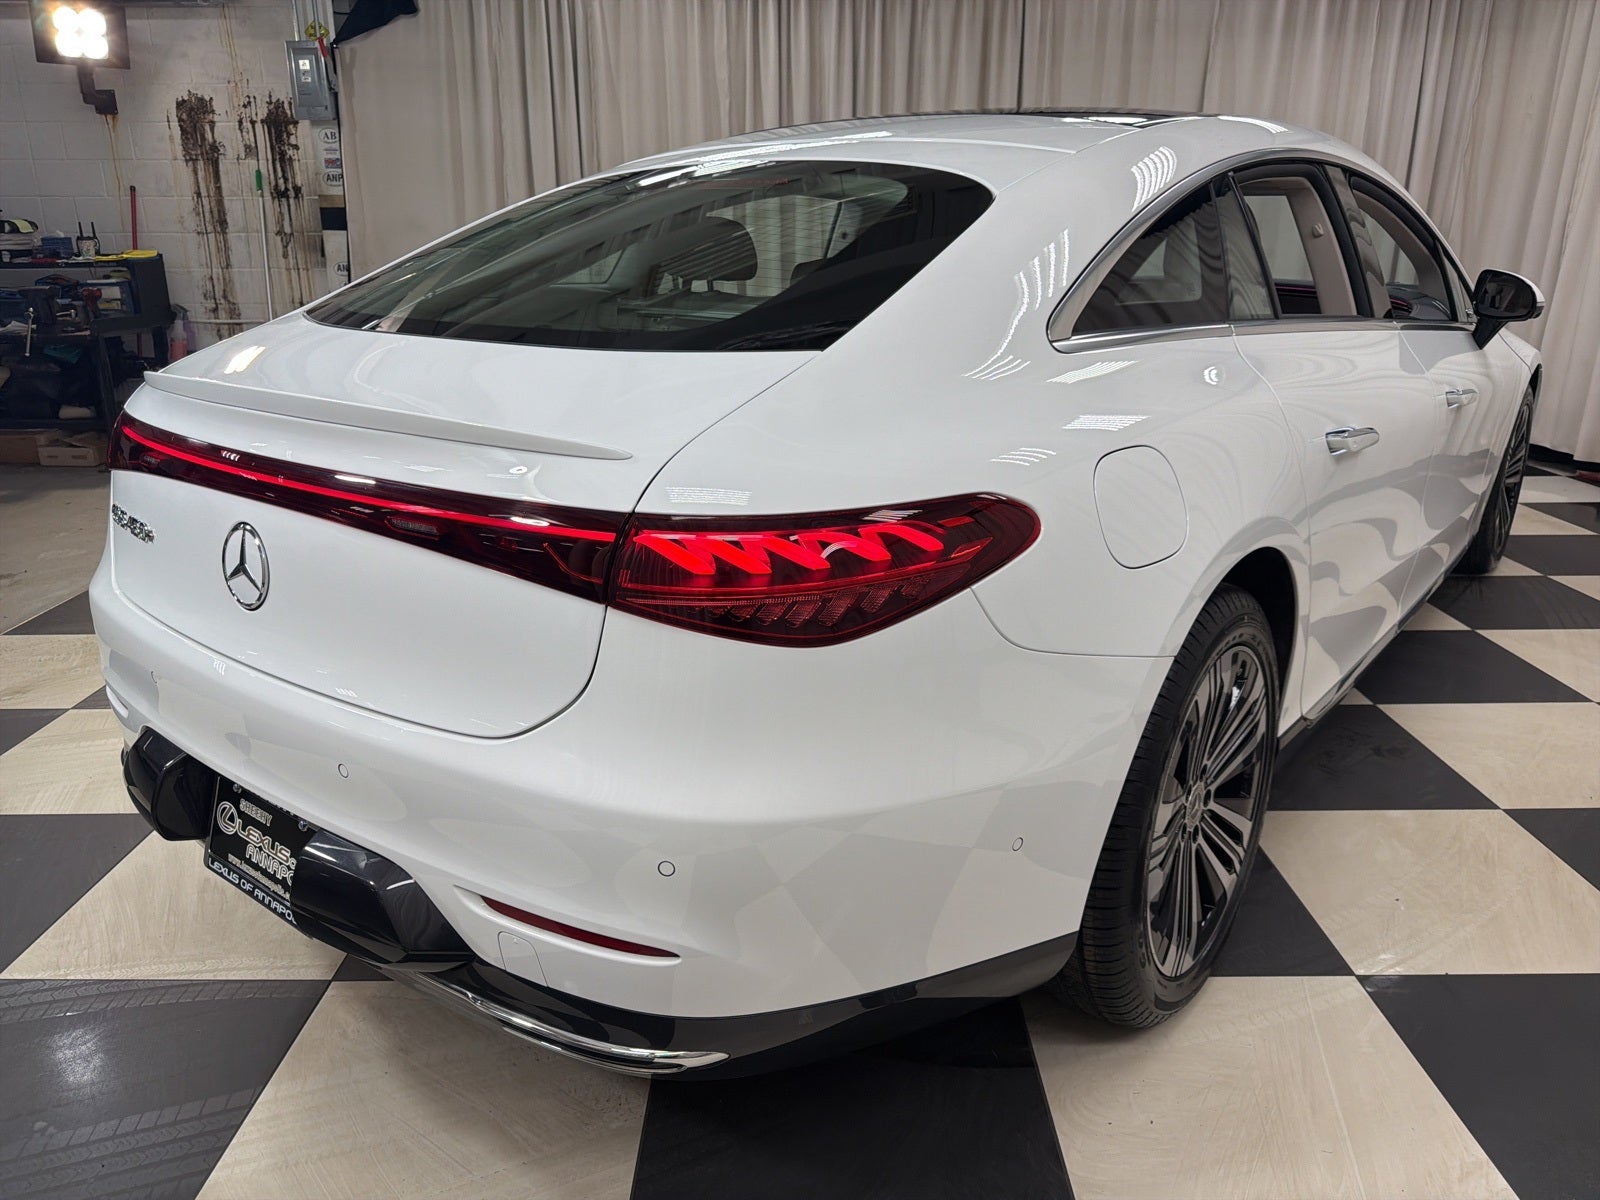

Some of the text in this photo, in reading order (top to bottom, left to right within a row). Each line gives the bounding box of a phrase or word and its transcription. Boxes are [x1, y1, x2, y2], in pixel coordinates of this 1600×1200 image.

[337, 263, 349, 272] AN
[239, 798, 273, 827] SHEEHY
[237, 818, 291, 866] LEXUS
[208, 857, 240, 884] LEXUS
[240, 879, 254, 892] OF
[246, 844, 295, 887] ANNAPO
